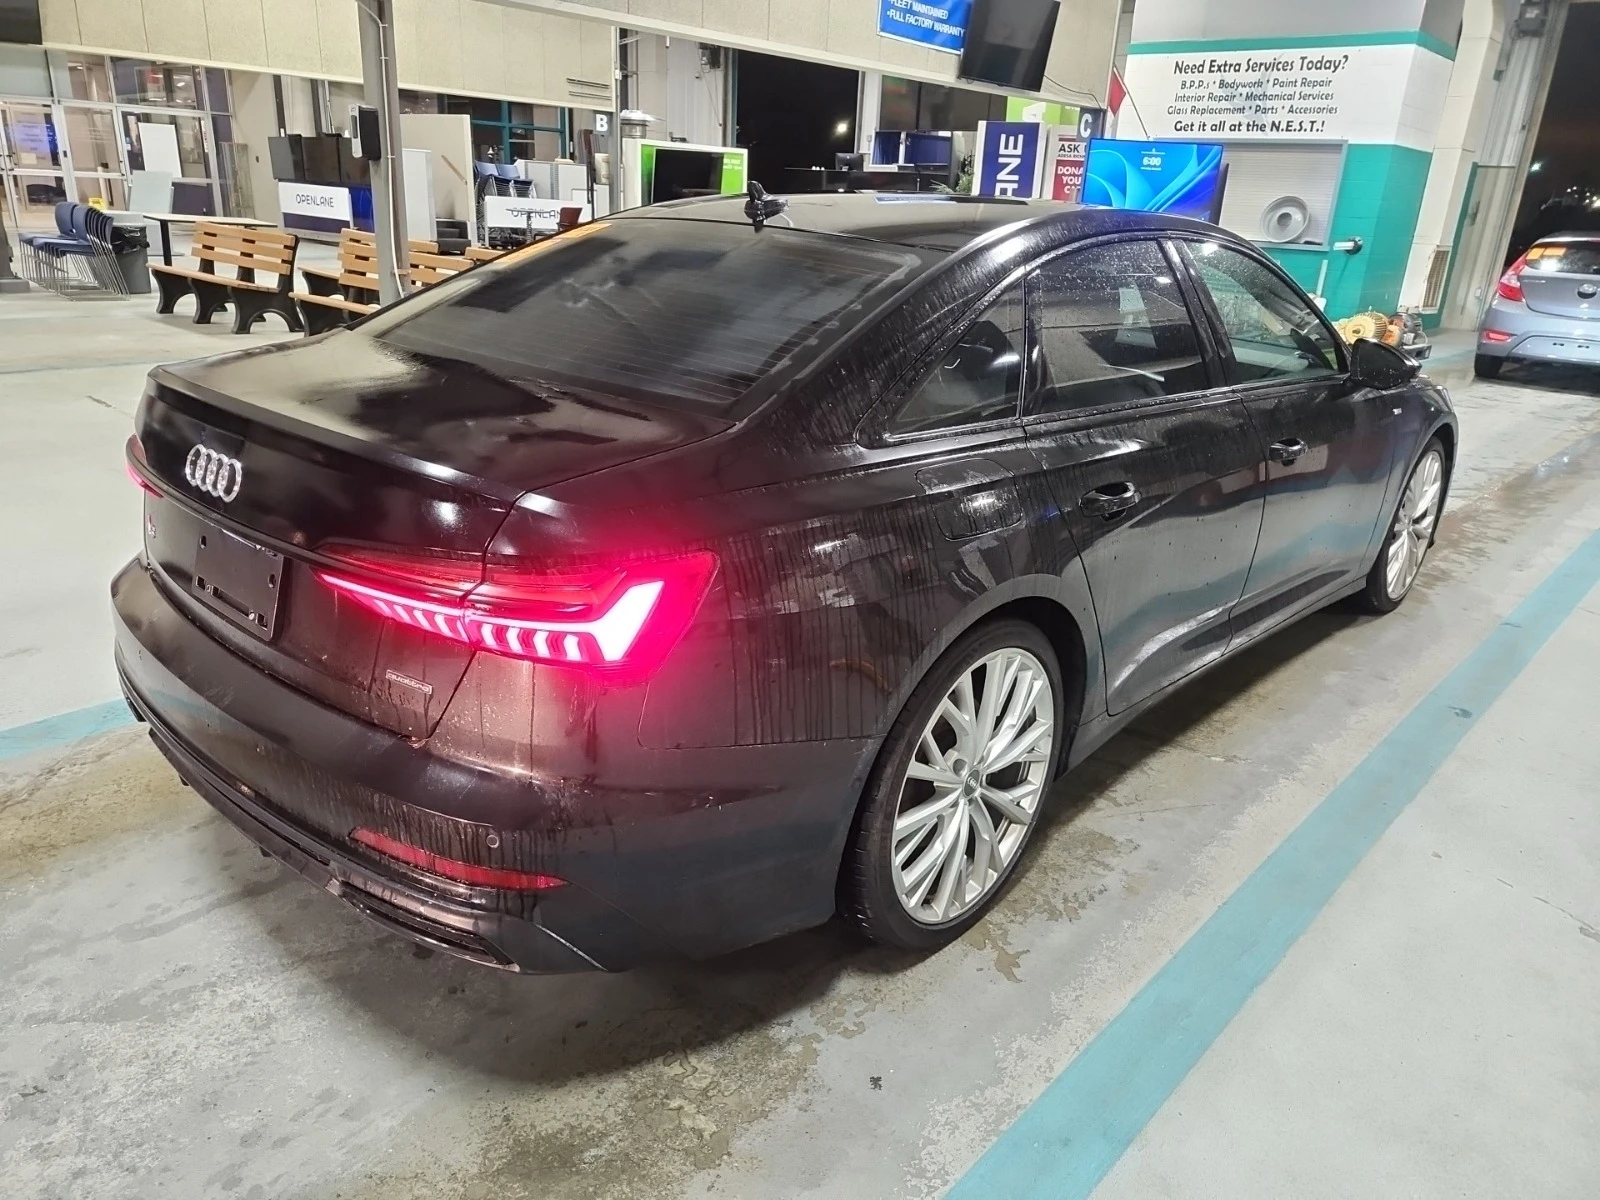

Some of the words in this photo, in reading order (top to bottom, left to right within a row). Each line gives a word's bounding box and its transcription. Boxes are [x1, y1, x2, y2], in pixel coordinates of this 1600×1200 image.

[912, 1, 949, 20] MAINTAINED
[889, 9, 905, 22] FULL
[905, 14, 934, 30] FACTORY
[934, 22, 965, 37] WARRANTY
[1174, 59, 1205, 74] Need
[1208, 59, 1242, 74] Extra
[1245, 57, 1295, 73] Services
[1299, 54, 1349, 73] Today?
[1180, 80, 1210, 90] B.P.P.s
[1218, 78, 1264, 91] Bodywork
[1272, 77, 1298, 88] Paint
[1300, 77, 1332, 89] Repair
[1174, 92, 1205, 103] Interior
[1207, 92, 1237, 104] Repair
[1244, 91, 1296, 101] Mechanical
[1298, 91, 1334, 101] Services
[1167, 105, 1188, 115] Glass
[1190, 105, 1246, 116] Replacement
[1254, 105, 1278, 115] Parts
[1287, 104, 1338, 115] Accessories
[595, 113, 609, 132] B
[1080, 113, 1093, 138] C
[1174, 120, 1194, 132] Get
[1198, 120, 1207, 132] it
[1210, 120, 1226, 132] all
[1229, 121, 1243, 132] at
[1246, 120, 1267, 132] the
[1270, 120, 1325, 132] N.E.S.T.!
[1058, 143, 1080, 153] ASK
[295, 193, 335, 208] OPENLANE
